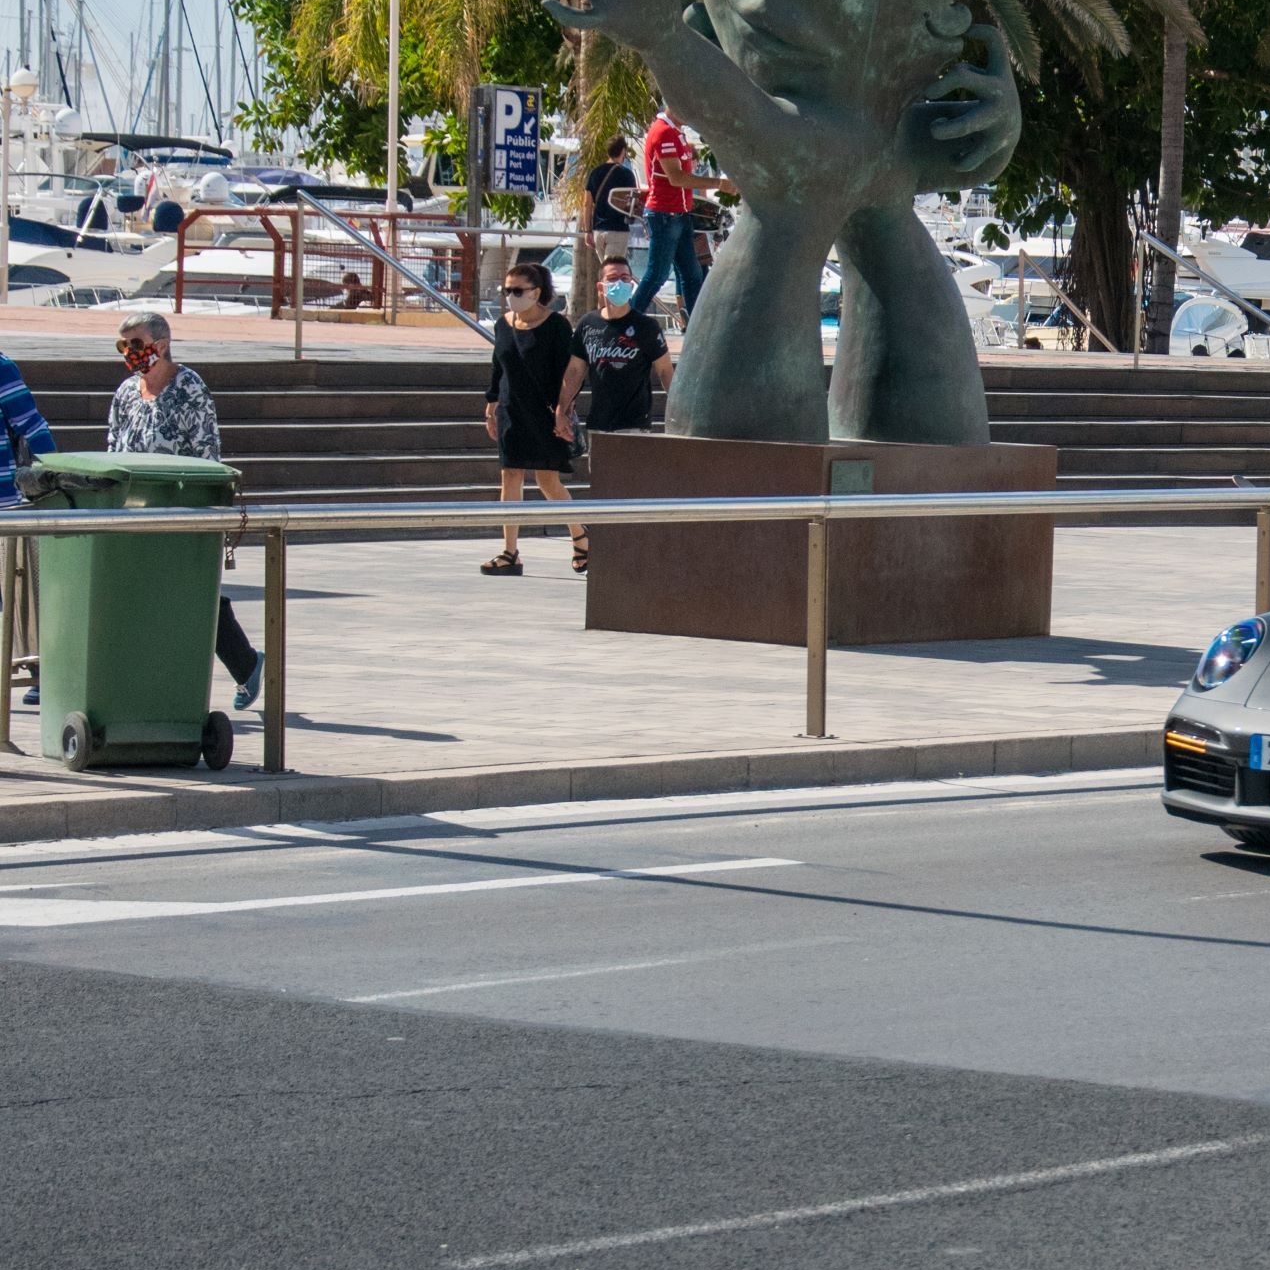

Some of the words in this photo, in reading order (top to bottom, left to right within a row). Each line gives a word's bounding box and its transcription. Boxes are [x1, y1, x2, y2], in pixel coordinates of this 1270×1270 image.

[495, 90, 522, 145] P
[506, 134, 536, 148] Públic
[526, 151, 536, 160] del
[510, 160, 523, 169] Port
[509, 172, 525, 182] Plaza
[526, 174, 535, 183] del
